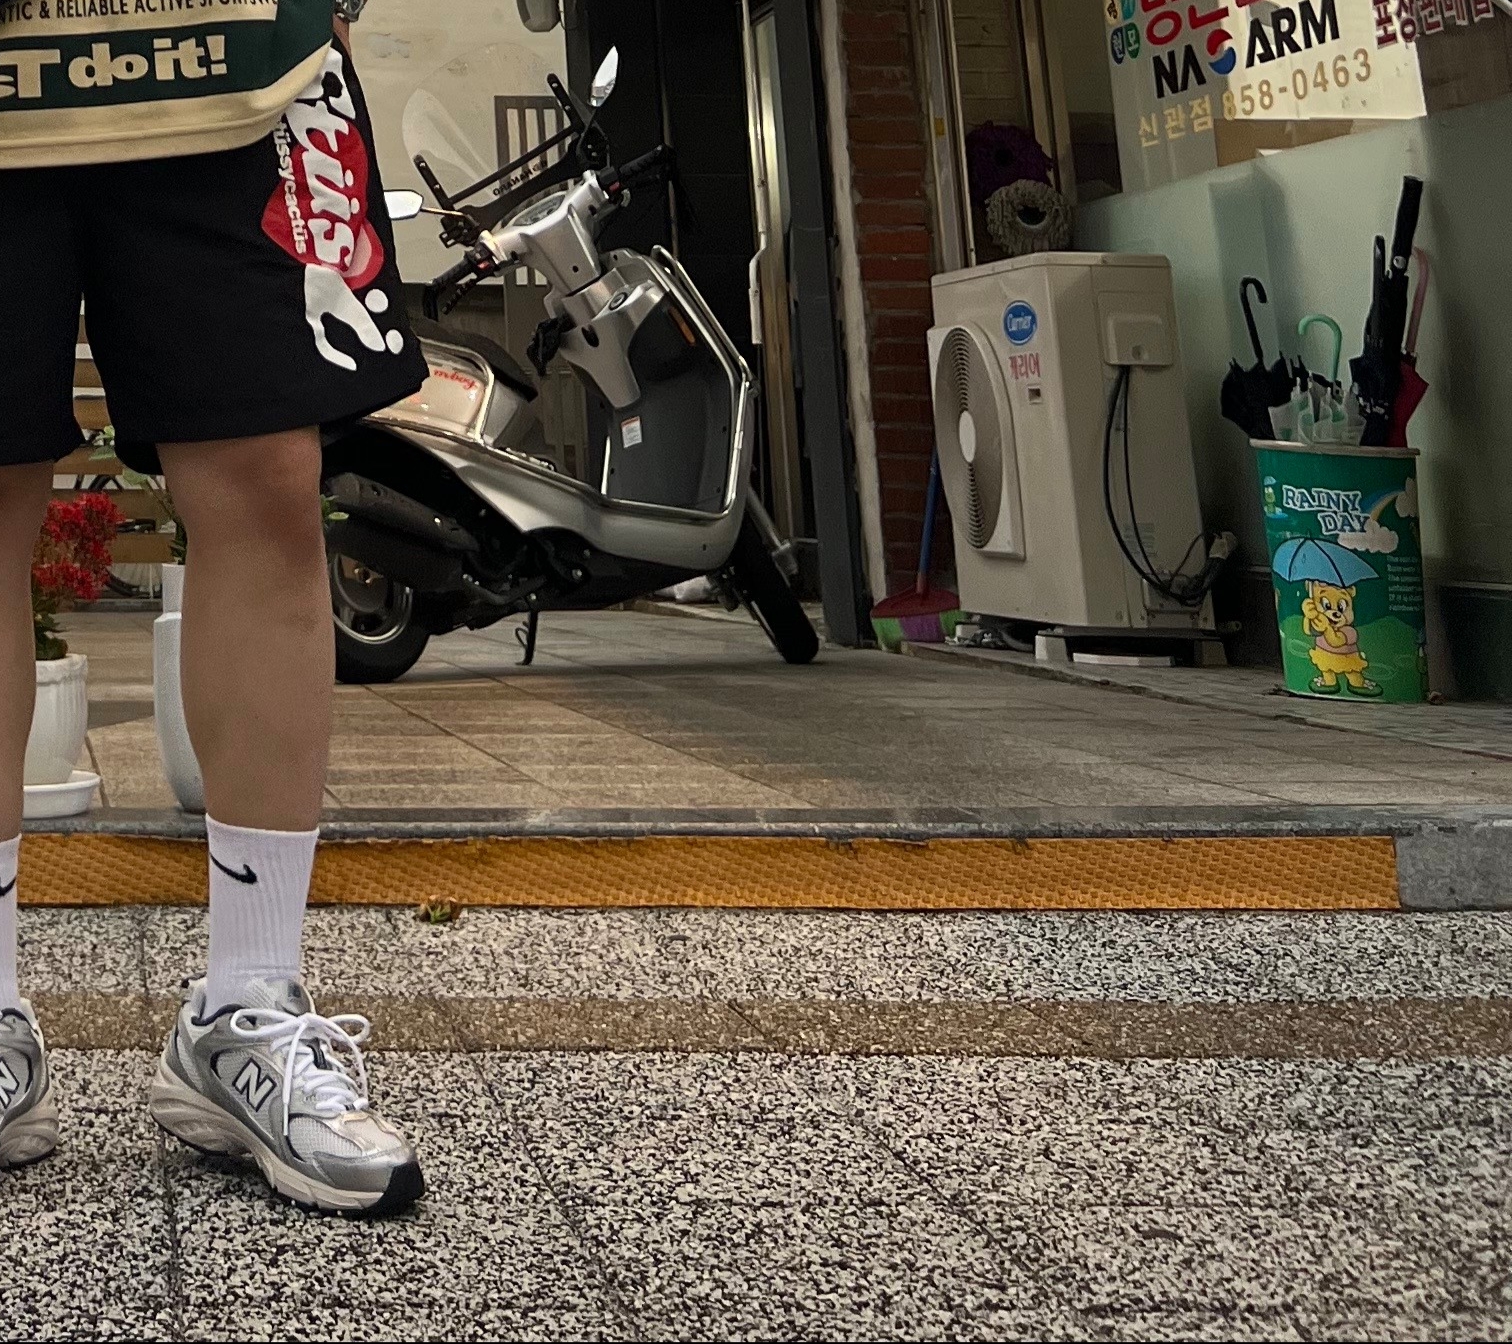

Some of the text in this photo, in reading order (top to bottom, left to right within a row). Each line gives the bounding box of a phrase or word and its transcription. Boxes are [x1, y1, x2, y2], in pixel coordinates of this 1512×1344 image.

[68, 42, 149, 88] do
[153, 34, 228, 82] it!
[1138, 48, 1373, 149] 신관점 858-0463
[1282, 484, 1363, 513] RAINY
[1317, 511, 1372, 535] DAY
